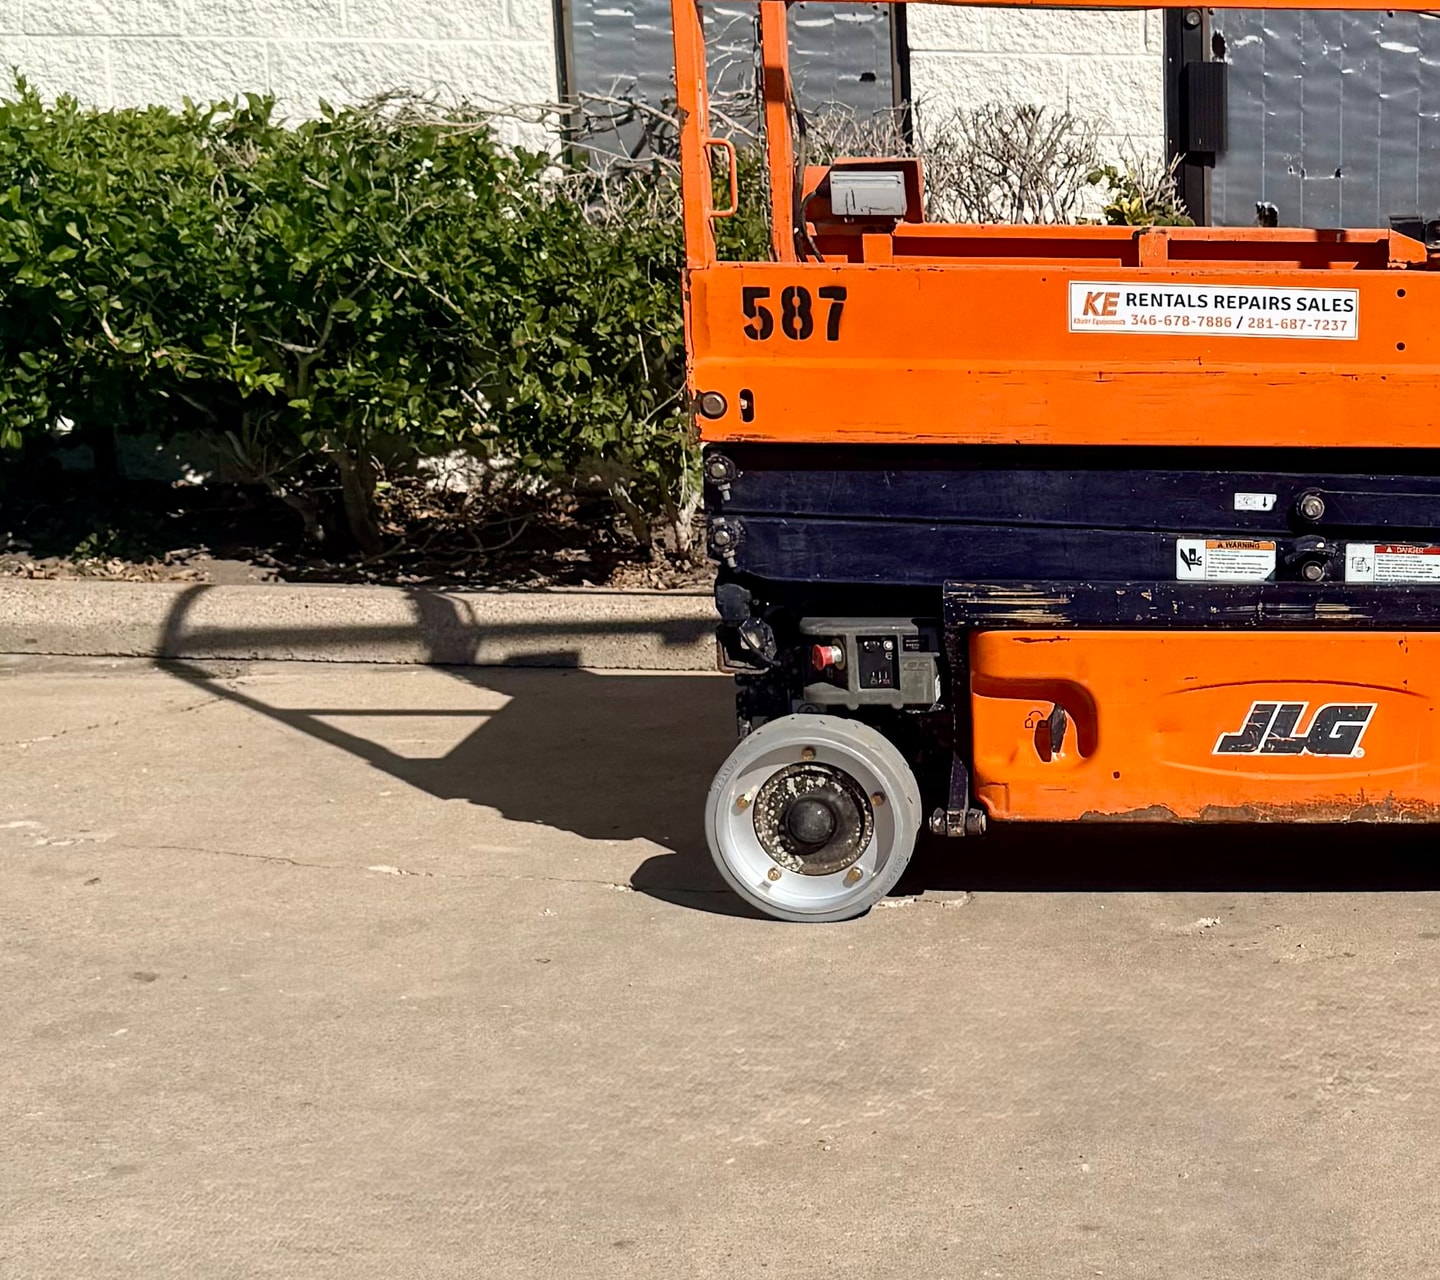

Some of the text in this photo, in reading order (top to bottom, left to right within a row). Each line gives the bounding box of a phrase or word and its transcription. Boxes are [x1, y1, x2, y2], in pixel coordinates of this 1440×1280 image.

[742, 285, 848, 342] 587
[1083, 291, 1120, 317] KE
[1126, 292, 1354, 313] RENTALS REPAIRS SALES
[1130, 314, 1232, 328] 346-678-7886
[1247, 317, 1348, 331] 281-687-7237
[1225, 542, 1260, 550] WARNING
[1216, 703, 1375, 756] JLG
